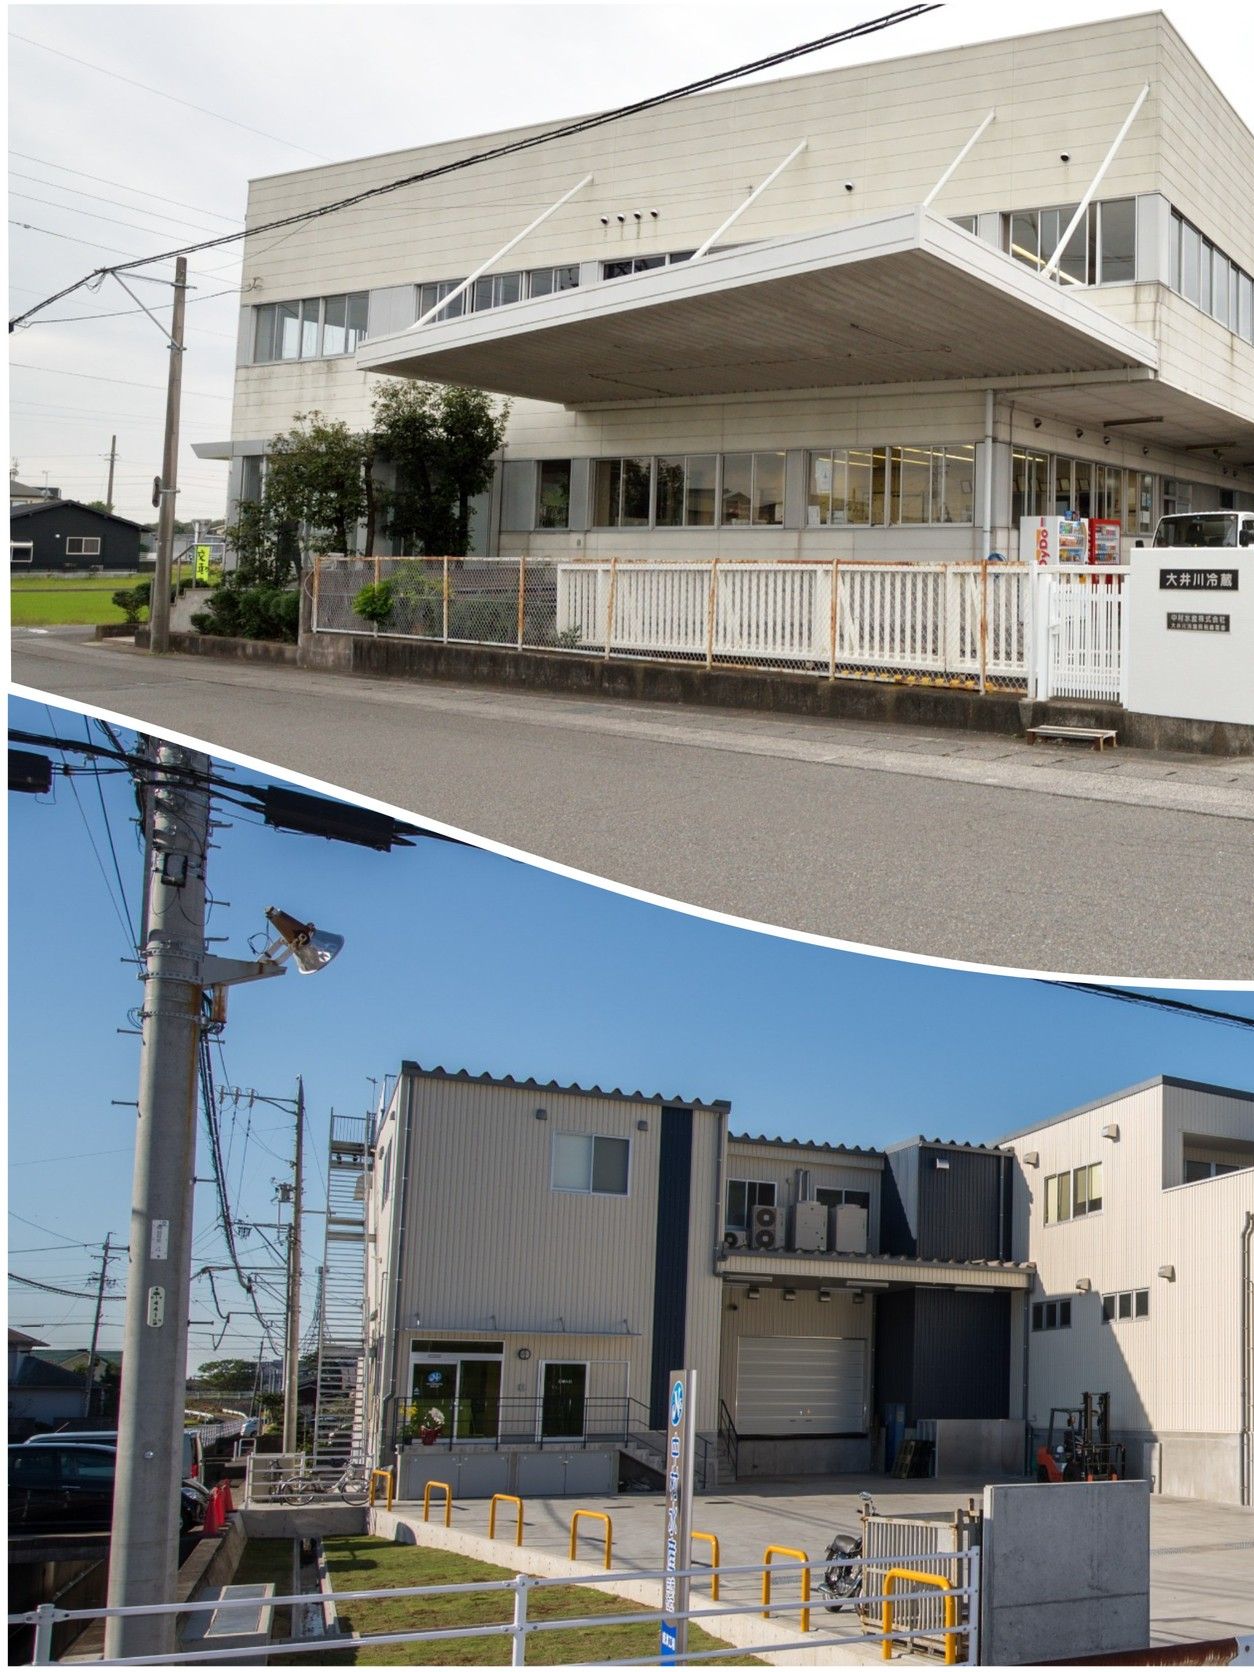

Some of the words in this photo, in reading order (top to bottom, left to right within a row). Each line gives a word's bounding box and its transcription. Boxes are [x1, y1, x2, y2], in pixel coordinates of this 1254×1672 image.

[1166, 573, 1233, 587] 大井川冷蔵
